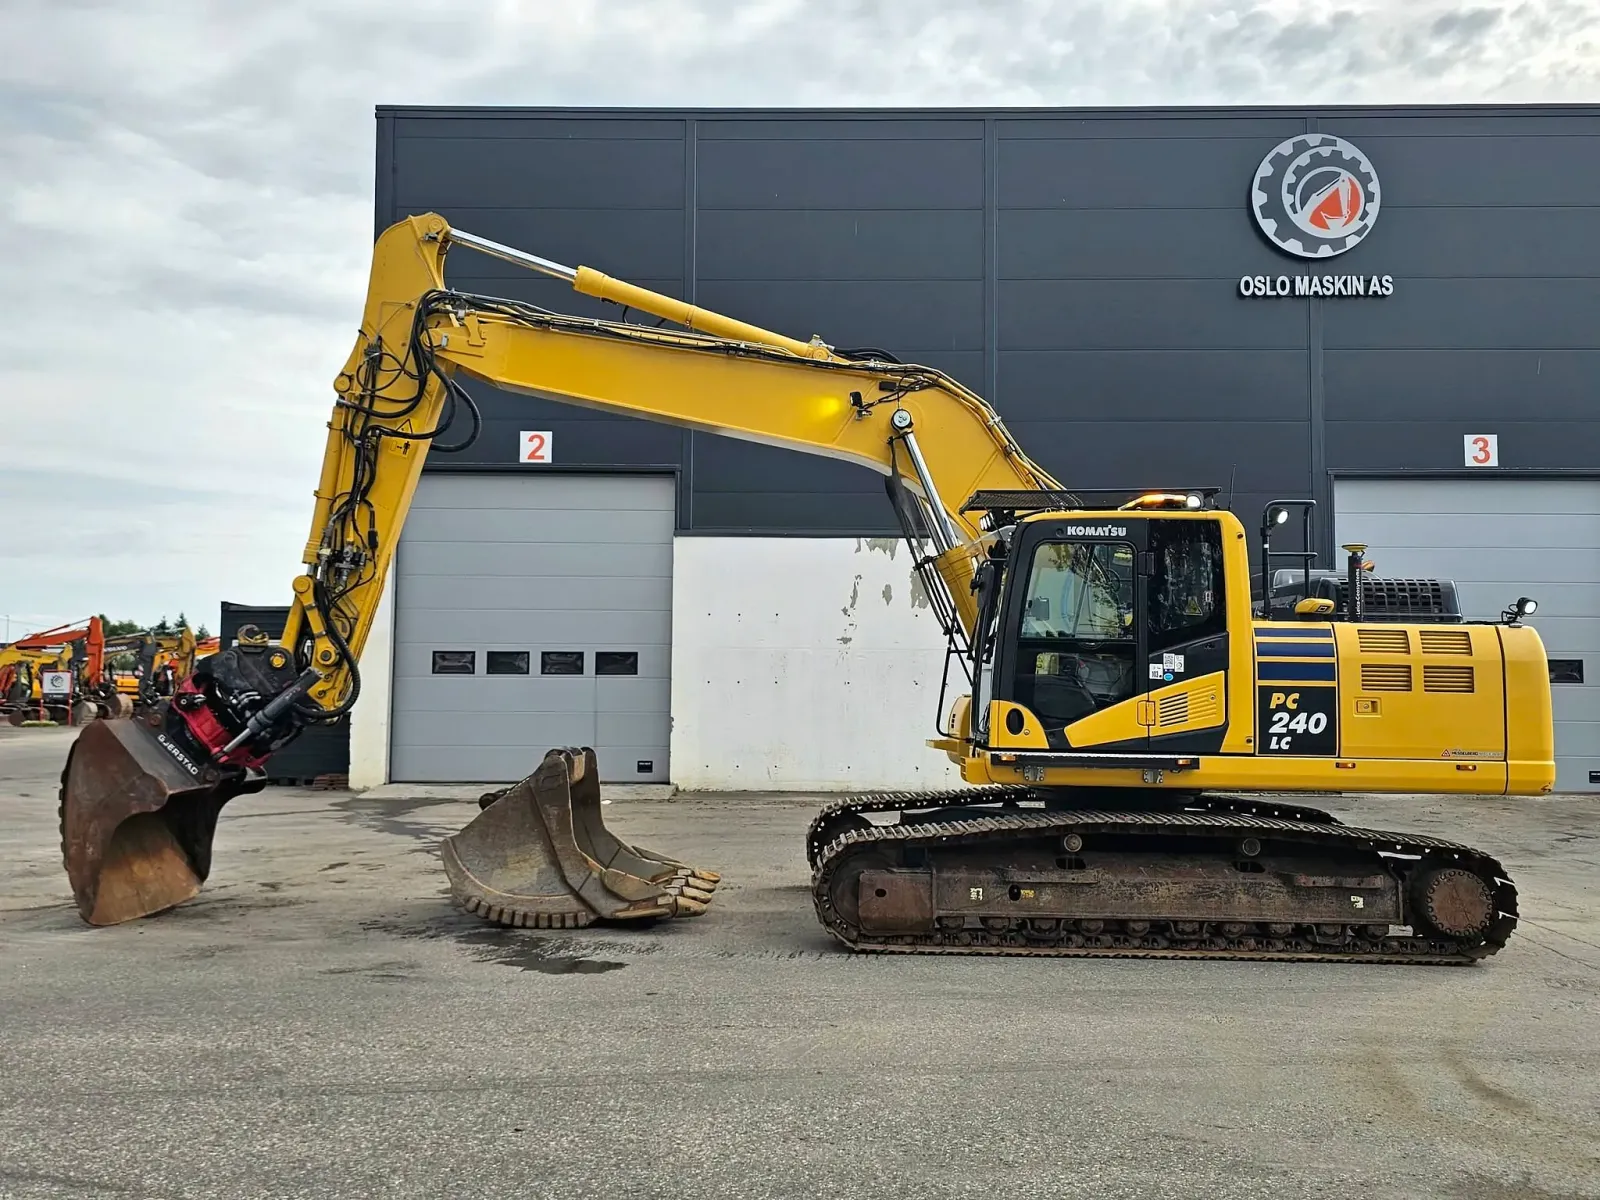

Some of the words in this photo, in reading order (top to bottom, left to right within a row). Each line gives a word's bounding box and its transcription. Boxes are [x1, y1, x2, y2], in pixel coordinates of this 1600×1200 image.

[1240, 276, 1290, 296] OSLO
[1295, 275, 1364, 296] MASKIN
[1368, 275, 1393, 295] AS
[527, 434, 545, 460] 2
[1472, 437, 1491, 464] 3
[1067, 524, 1127, 537] KOMATSU
[1269, 692, 1300, 709] PC
[1268, 711, 1328, 734] 240
[1269, 736, 1292, 750] LC
[157, 734, 199, 775] GJERSTAD
